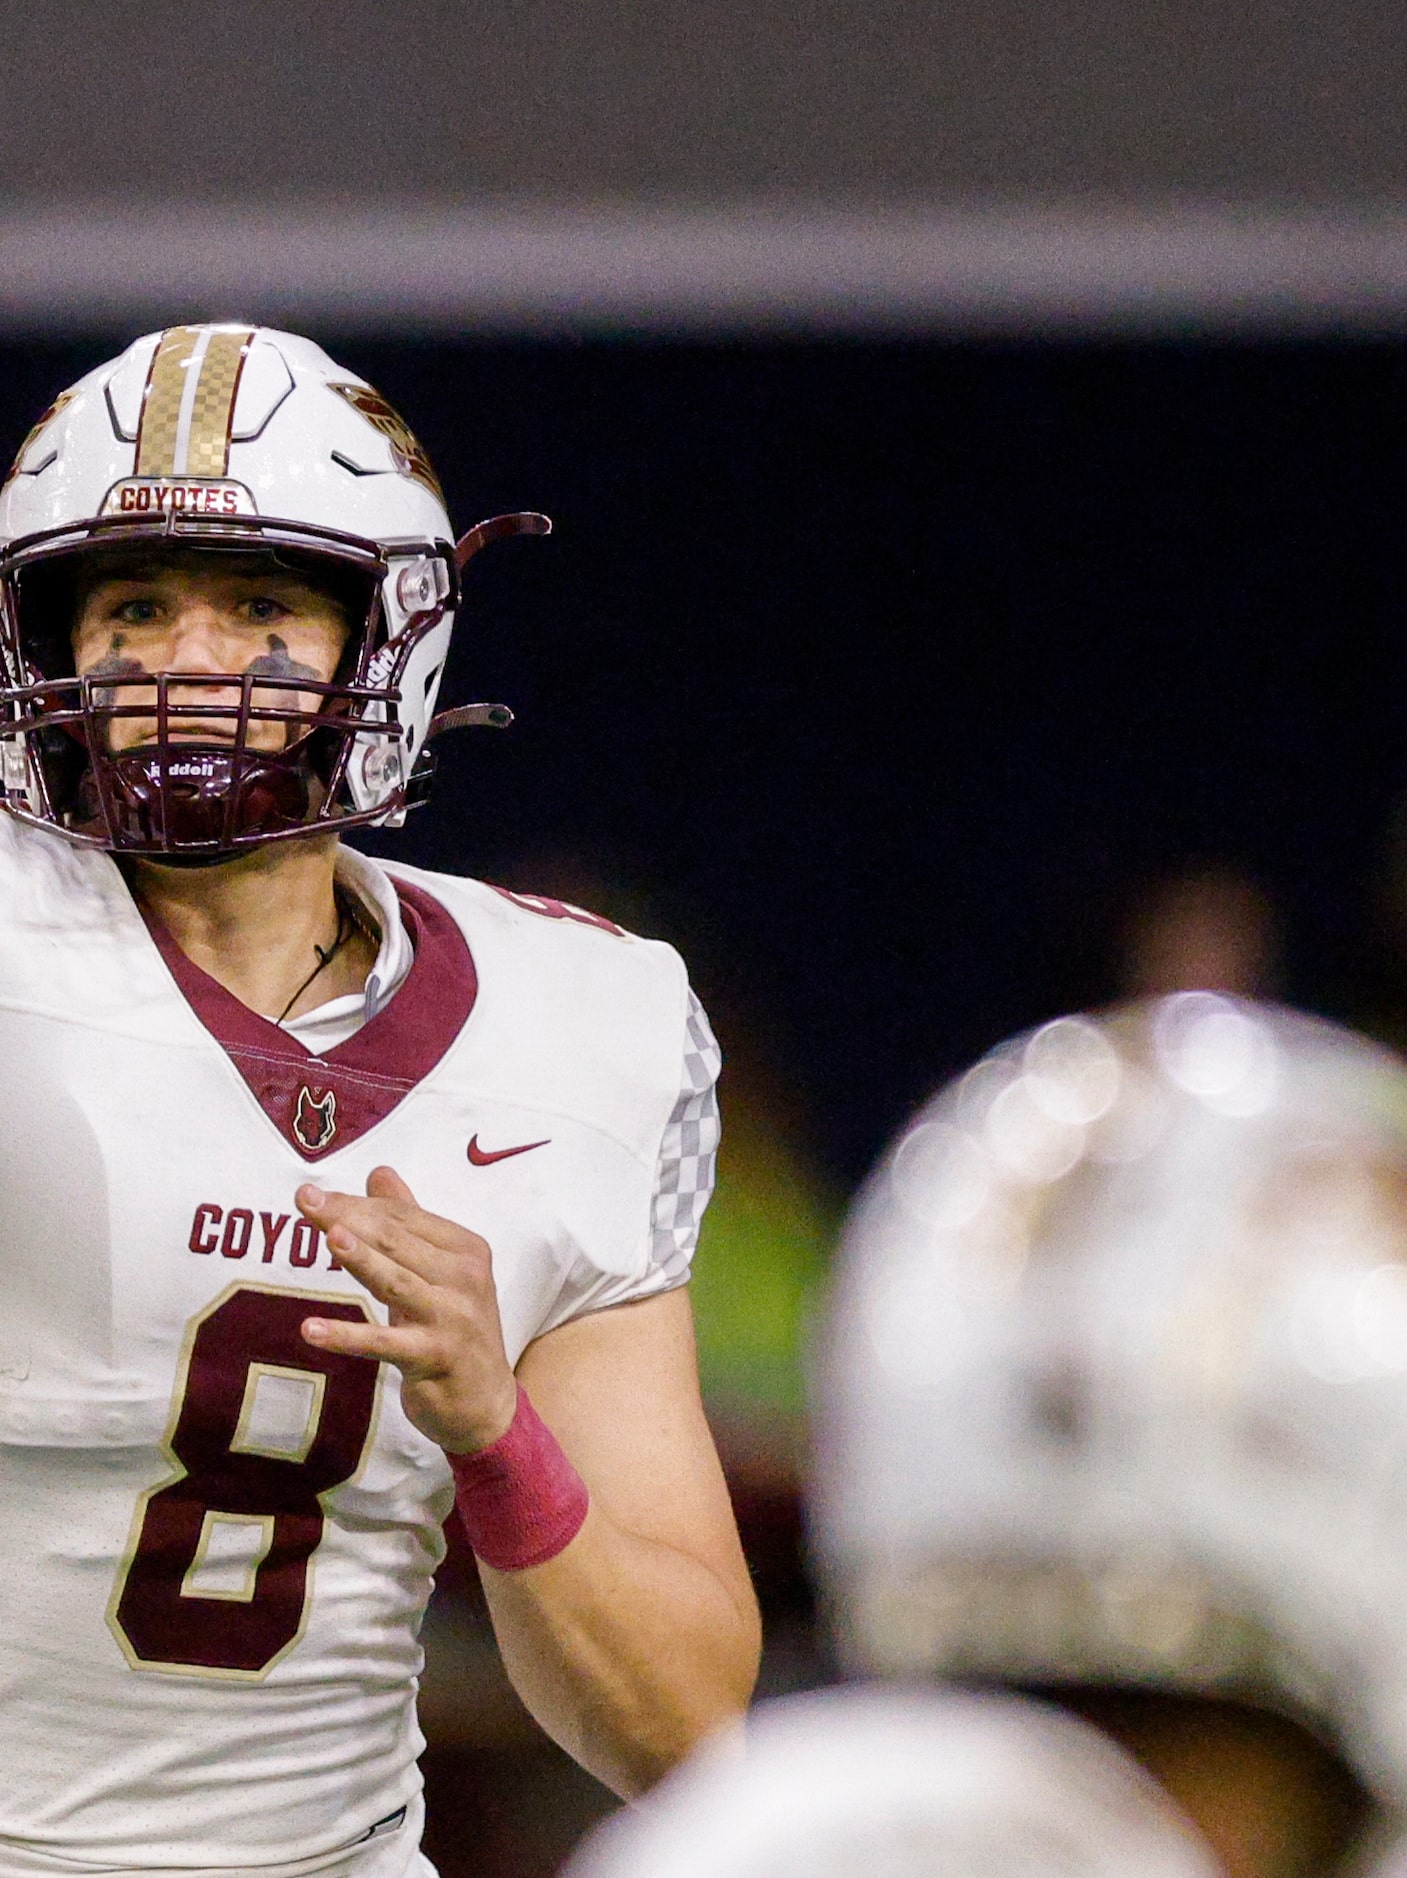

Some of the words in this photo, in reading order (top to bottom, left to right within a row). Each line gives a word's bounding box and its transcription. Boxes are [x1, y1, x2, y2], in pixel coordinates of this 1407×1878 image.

[120, 486, 238, 514] COYOTES
[150, 763, 214, 776] Rddell
[188, 1203, 343, 1271] COYO
[105, 1279, 388, 1681] 8
